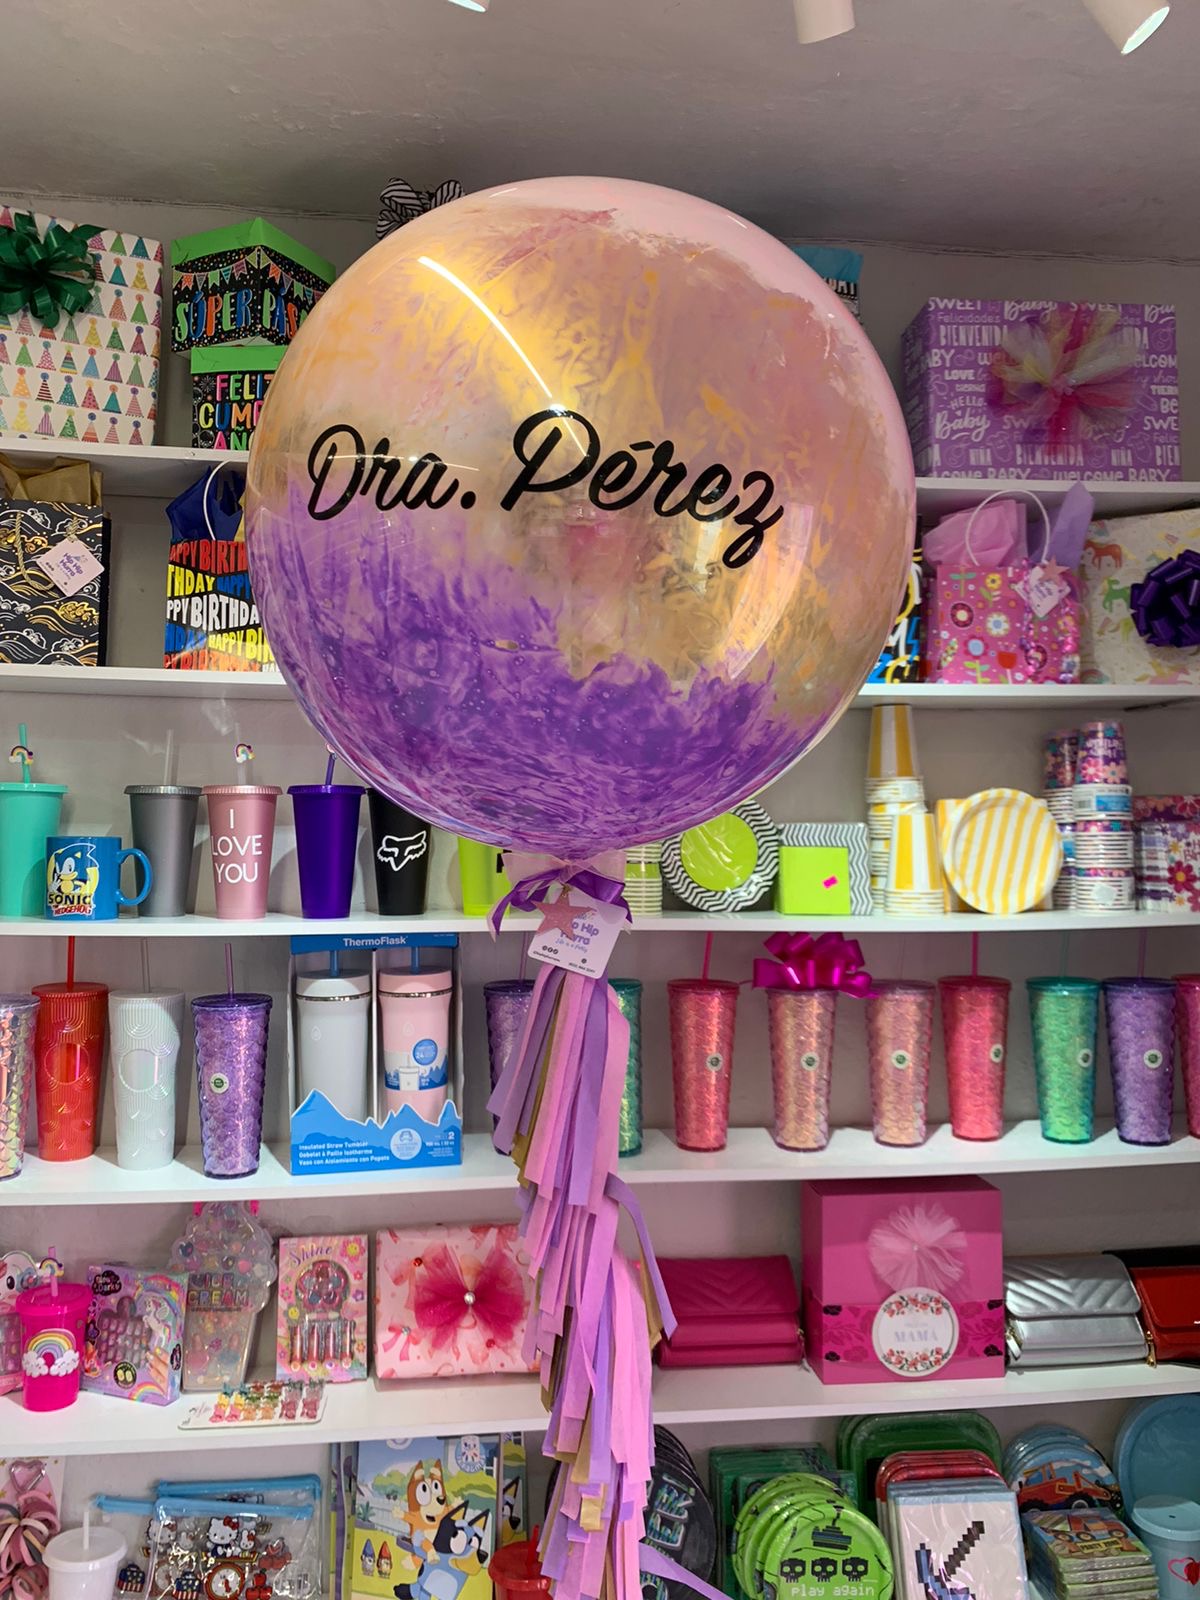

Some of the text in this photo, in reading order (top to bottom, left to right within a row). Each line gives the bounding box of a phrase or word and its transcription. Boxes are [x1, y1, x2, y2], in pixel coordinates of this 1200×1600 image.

[935, 407, 991, 442] Baby
[308, 408, 785, 569] Dra. Pérez
[230, 808, 234, 829] I
[211, 834, 262, 856] LOVE
[214, 862, 258, 883] YOU
[48, 893, 91, 905] SONIC
[342, 935, 406, 947] ThermoFlask
[791, 1584, 875, 1597] play again
